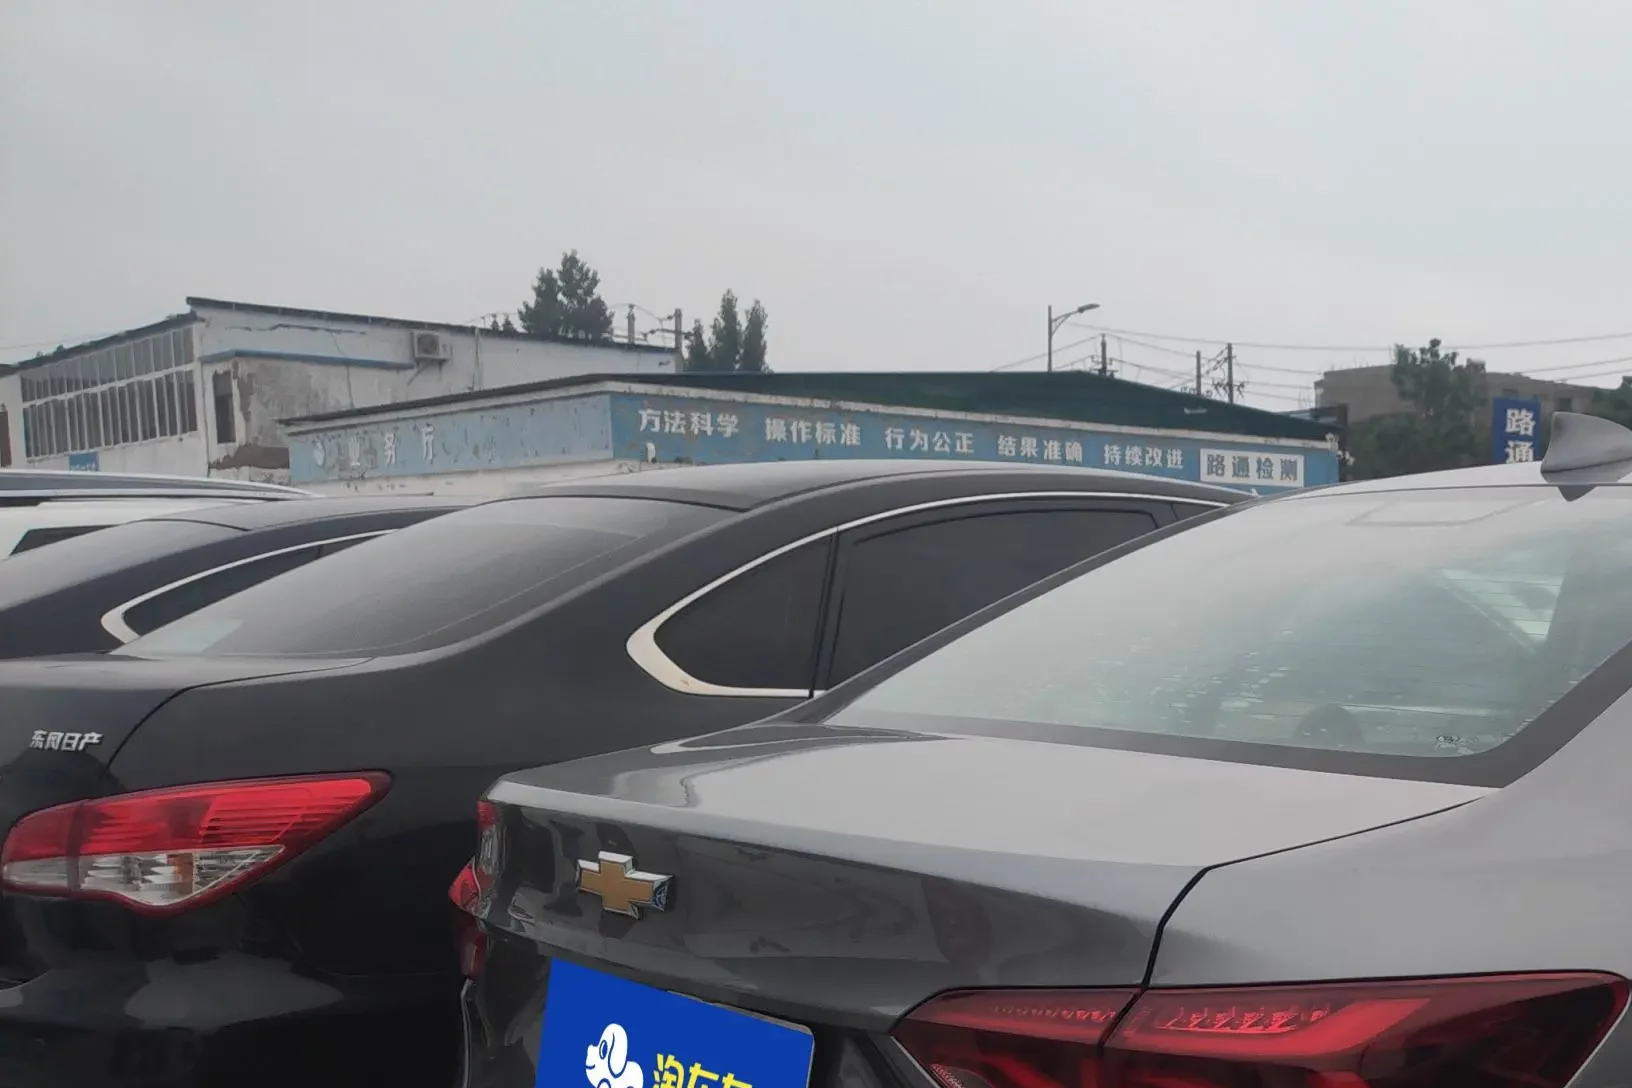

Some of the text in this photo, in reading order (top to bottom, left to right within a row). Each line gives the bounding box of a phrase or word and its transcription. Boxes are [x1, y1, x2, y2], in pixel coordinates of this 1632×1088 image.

[638, 408, 1183, 469] 方法科学 操作标准 行为公正 结果准确 持续改进
[1505, 408, 1536, 464] 路通
[1207, 454, 1298, 481] 路通检测
[30, 729, 104, 751] 东风日产
